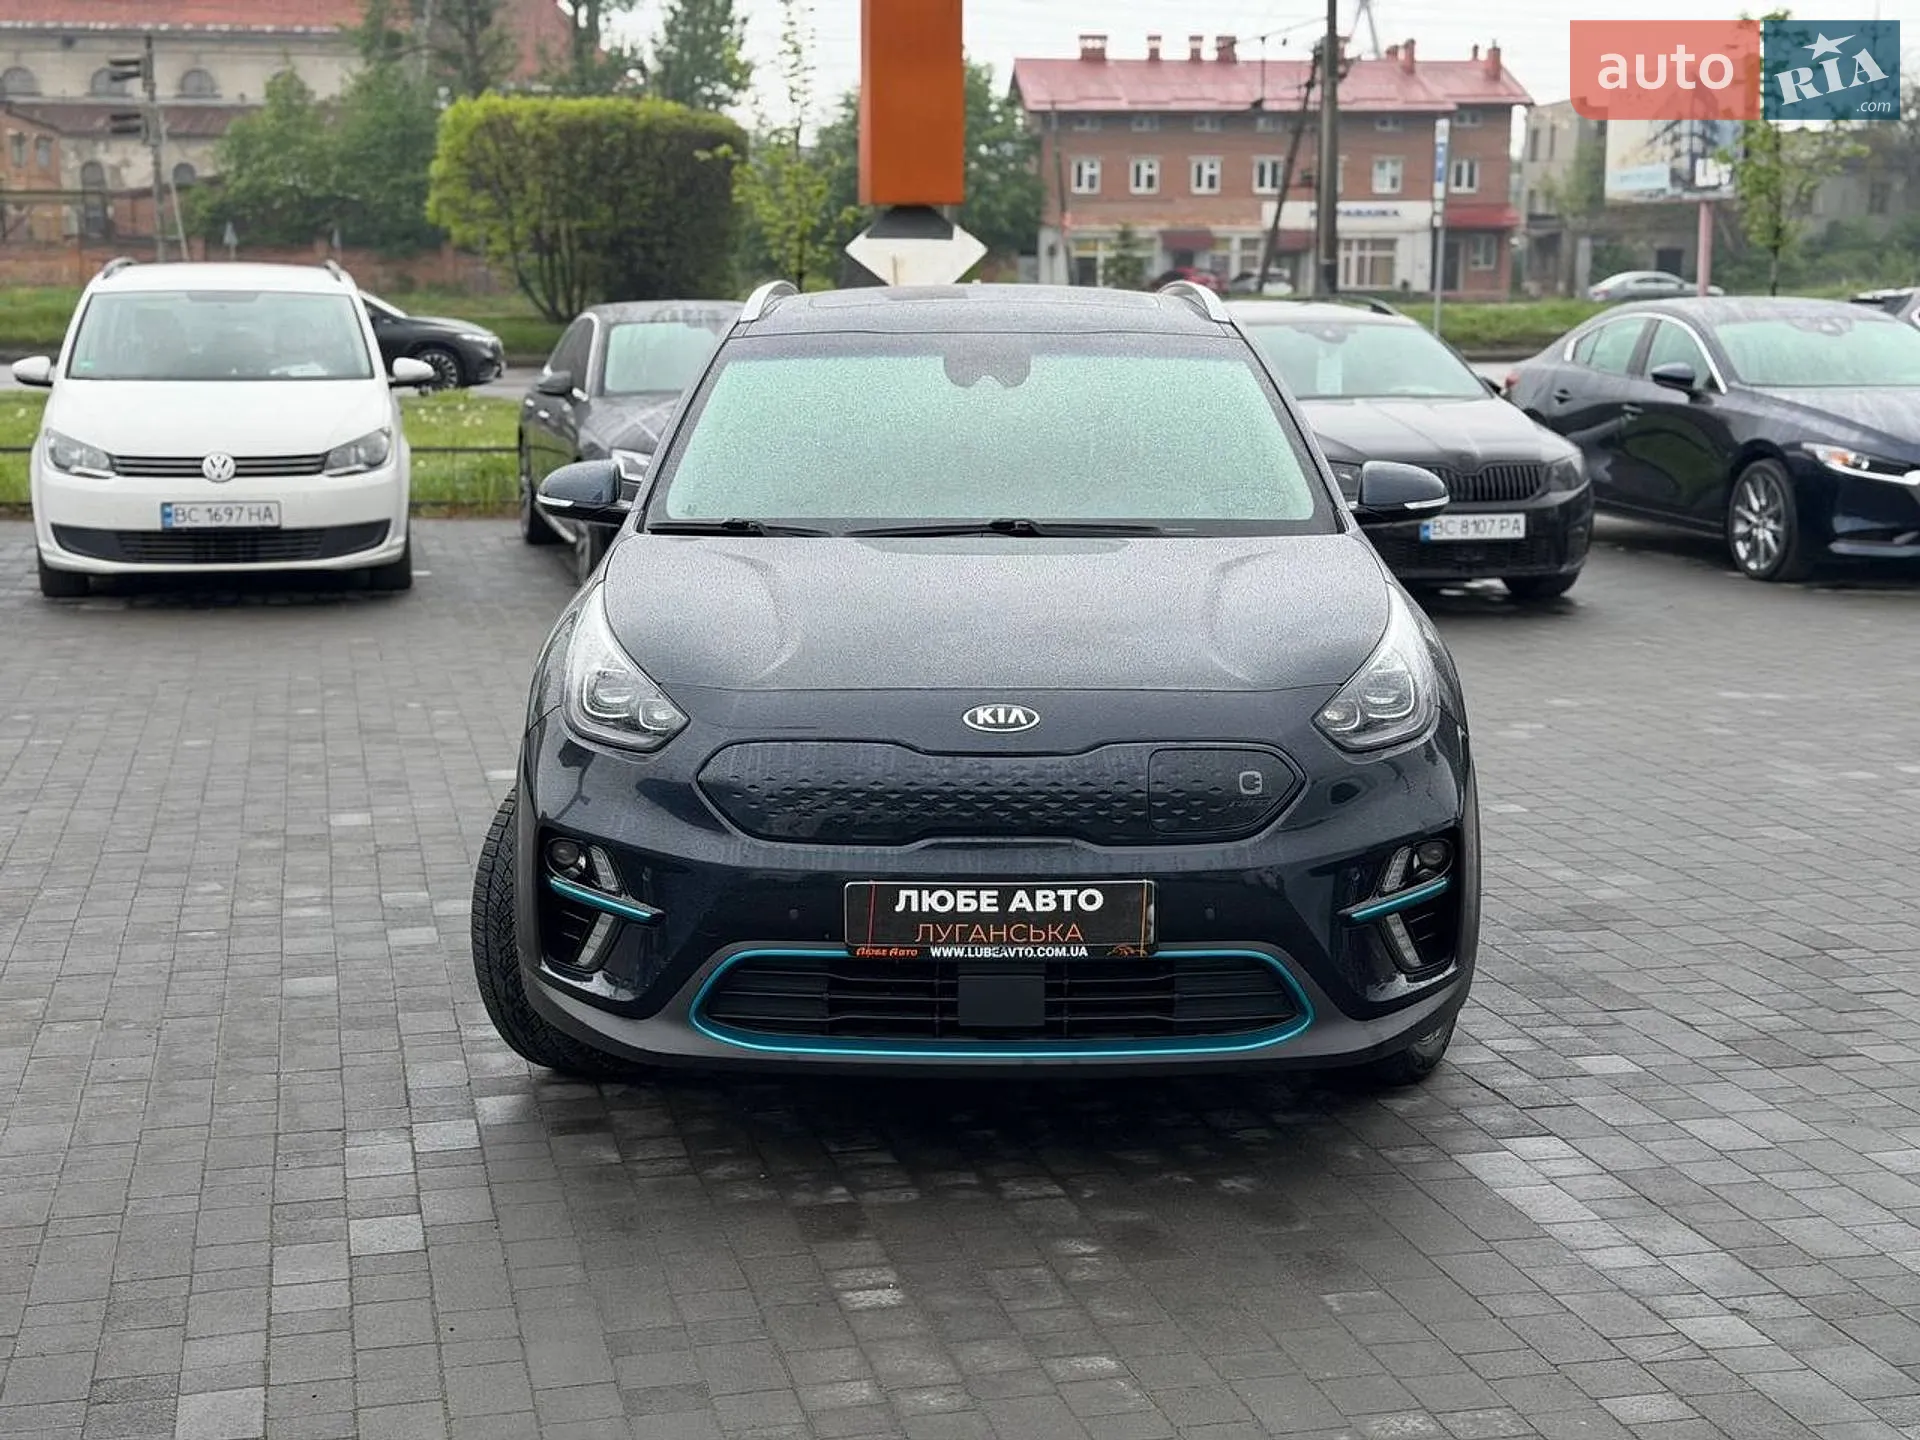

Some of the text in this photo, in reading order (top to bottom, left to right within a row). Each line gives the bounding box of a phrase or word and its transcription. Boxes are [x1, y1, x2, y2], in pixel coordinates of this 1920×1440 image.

[206, 506, 244, 522] 1697
[977, 707, 1028, 725] KIA
[894, 888, 1104, 913] ЛЮБЕ АВТО
[914, 923, 1084, 943] ЛУГАНСЬКА
